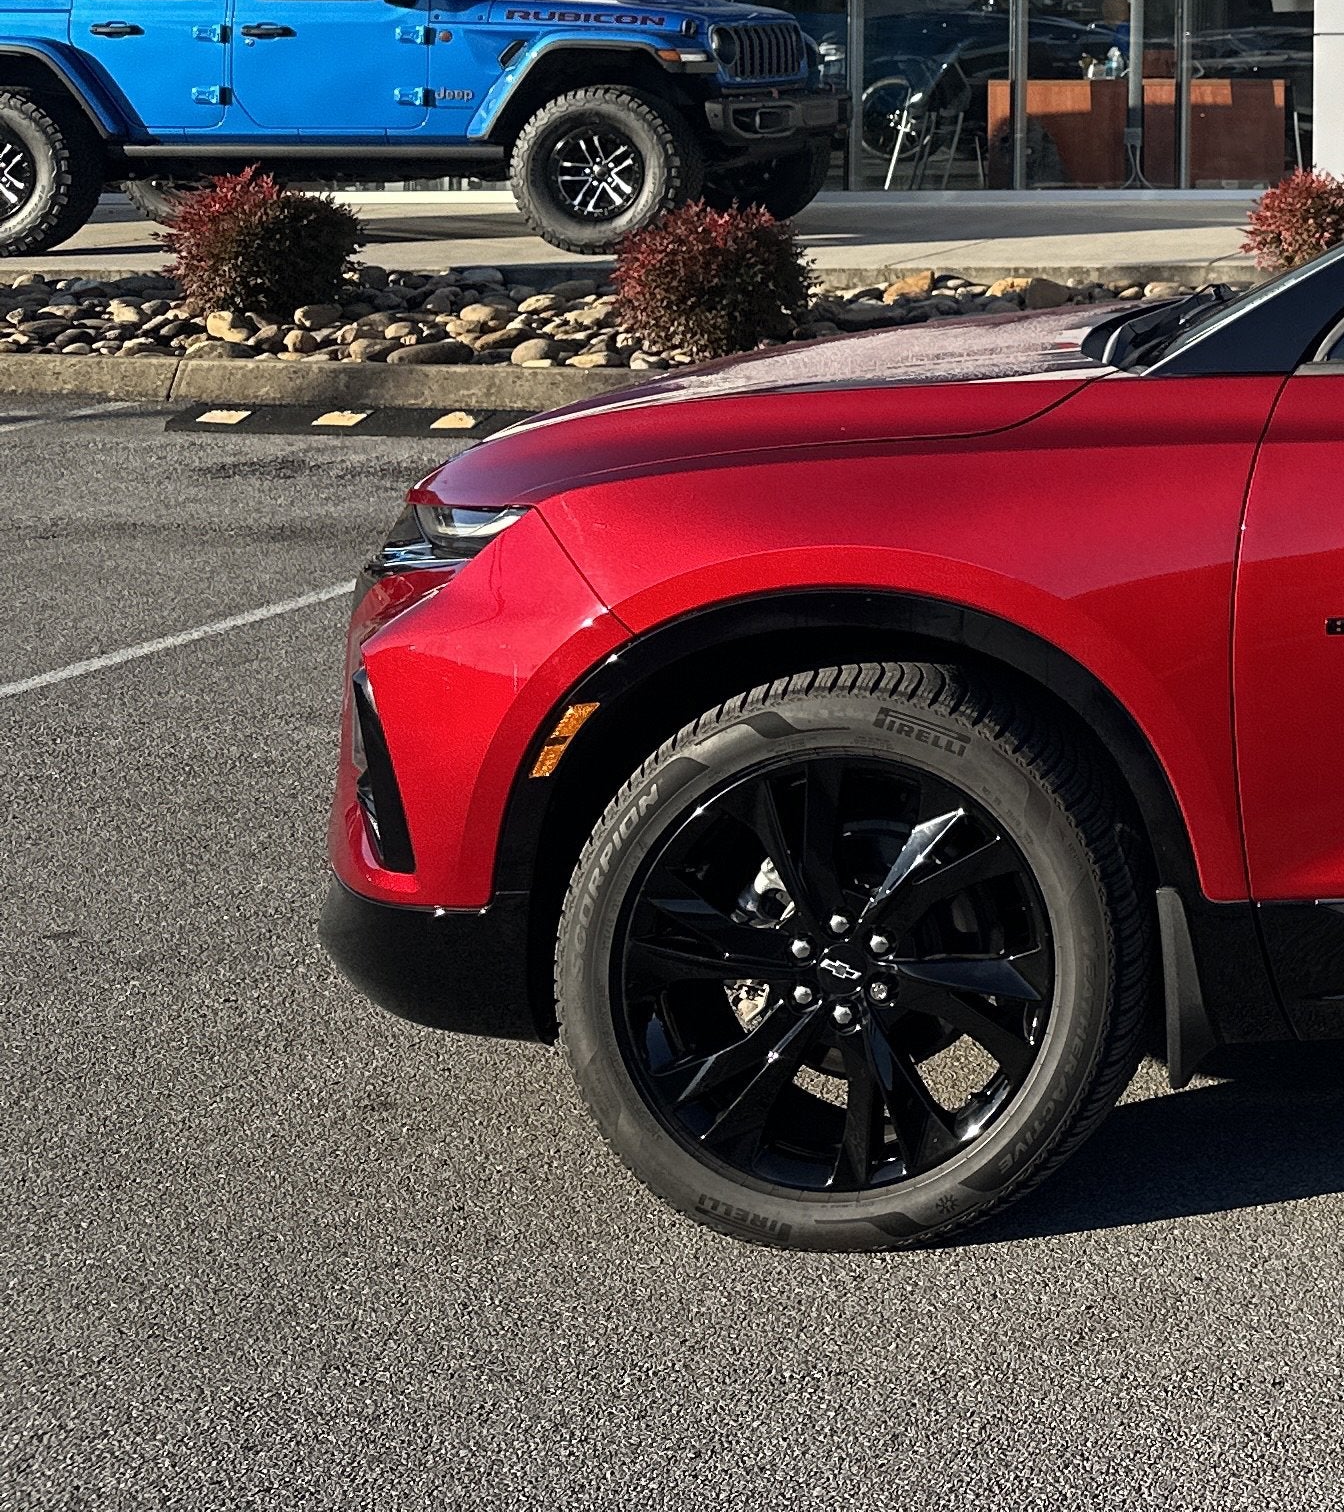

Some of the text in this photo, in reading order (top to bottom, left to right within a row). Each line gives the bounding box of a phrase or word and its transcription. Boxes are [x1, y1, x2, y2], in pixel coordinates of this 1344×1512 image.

[505, 9, 665, 26] RUBICON
[871, 706, 972, 758] PIRELLI
[571, 783, 660, 983] SCORPION
[695, 1193, 793, 1243] PIRELLI
